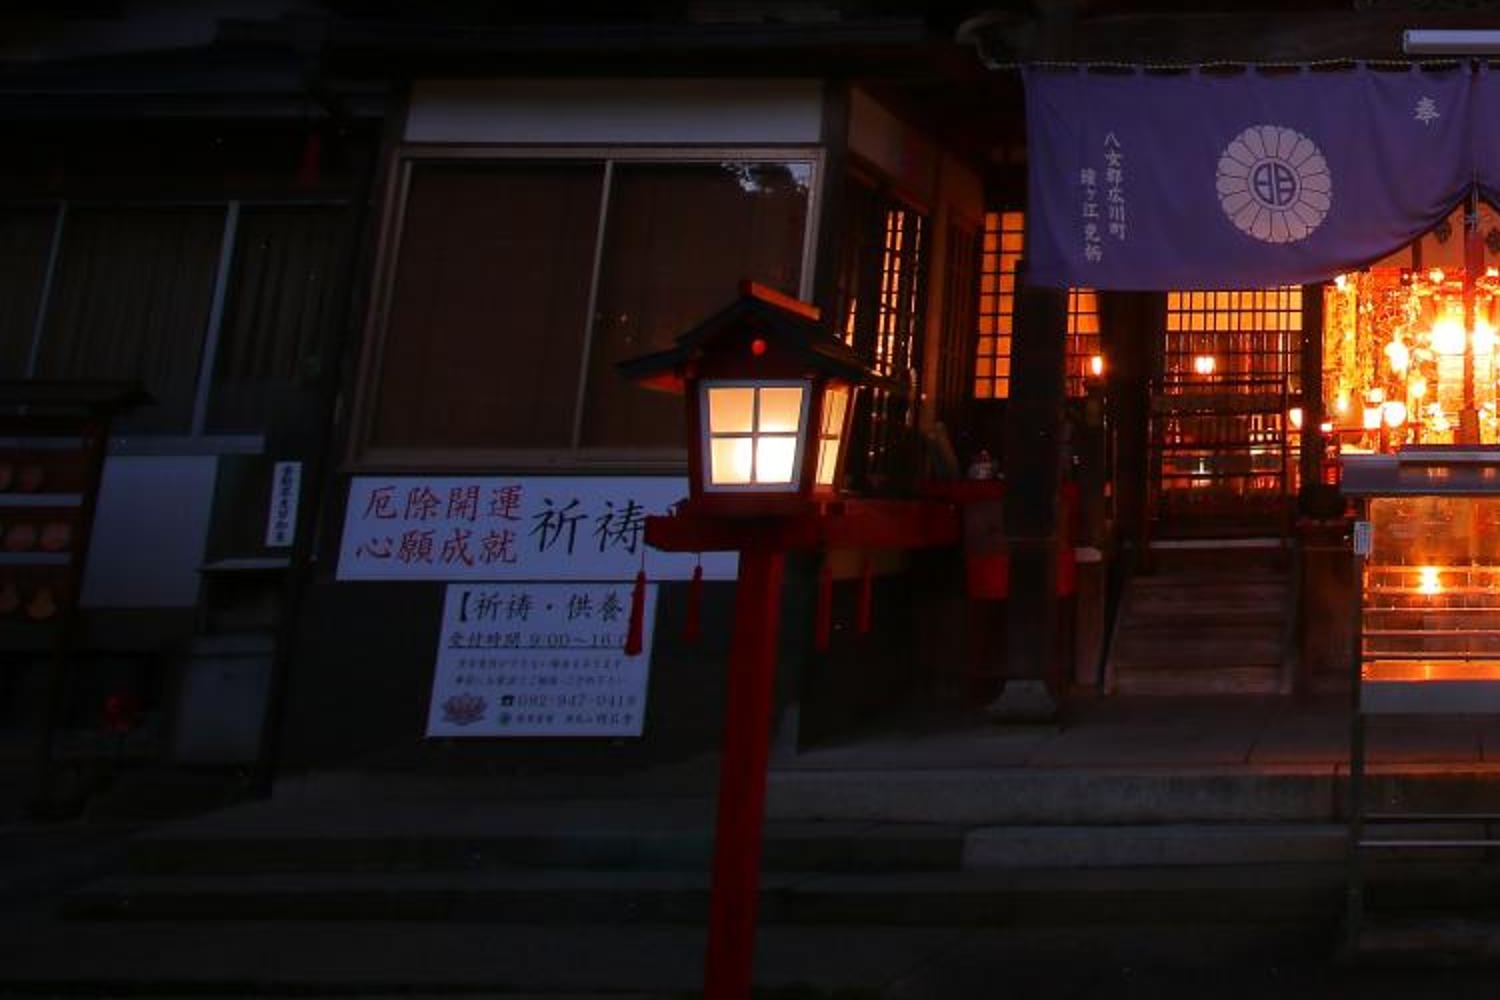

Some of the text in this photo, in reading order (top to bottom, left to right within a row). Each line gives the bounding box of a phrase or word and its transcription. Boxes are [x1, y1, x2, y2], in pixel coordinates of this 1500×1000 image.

[362, 484, 523, 522] 厄除開運
[528, 498, 688, 556] 祈祷
[355, 527, 519, 567] 心願成就
[449, 631, 522, 647] 受付時間
